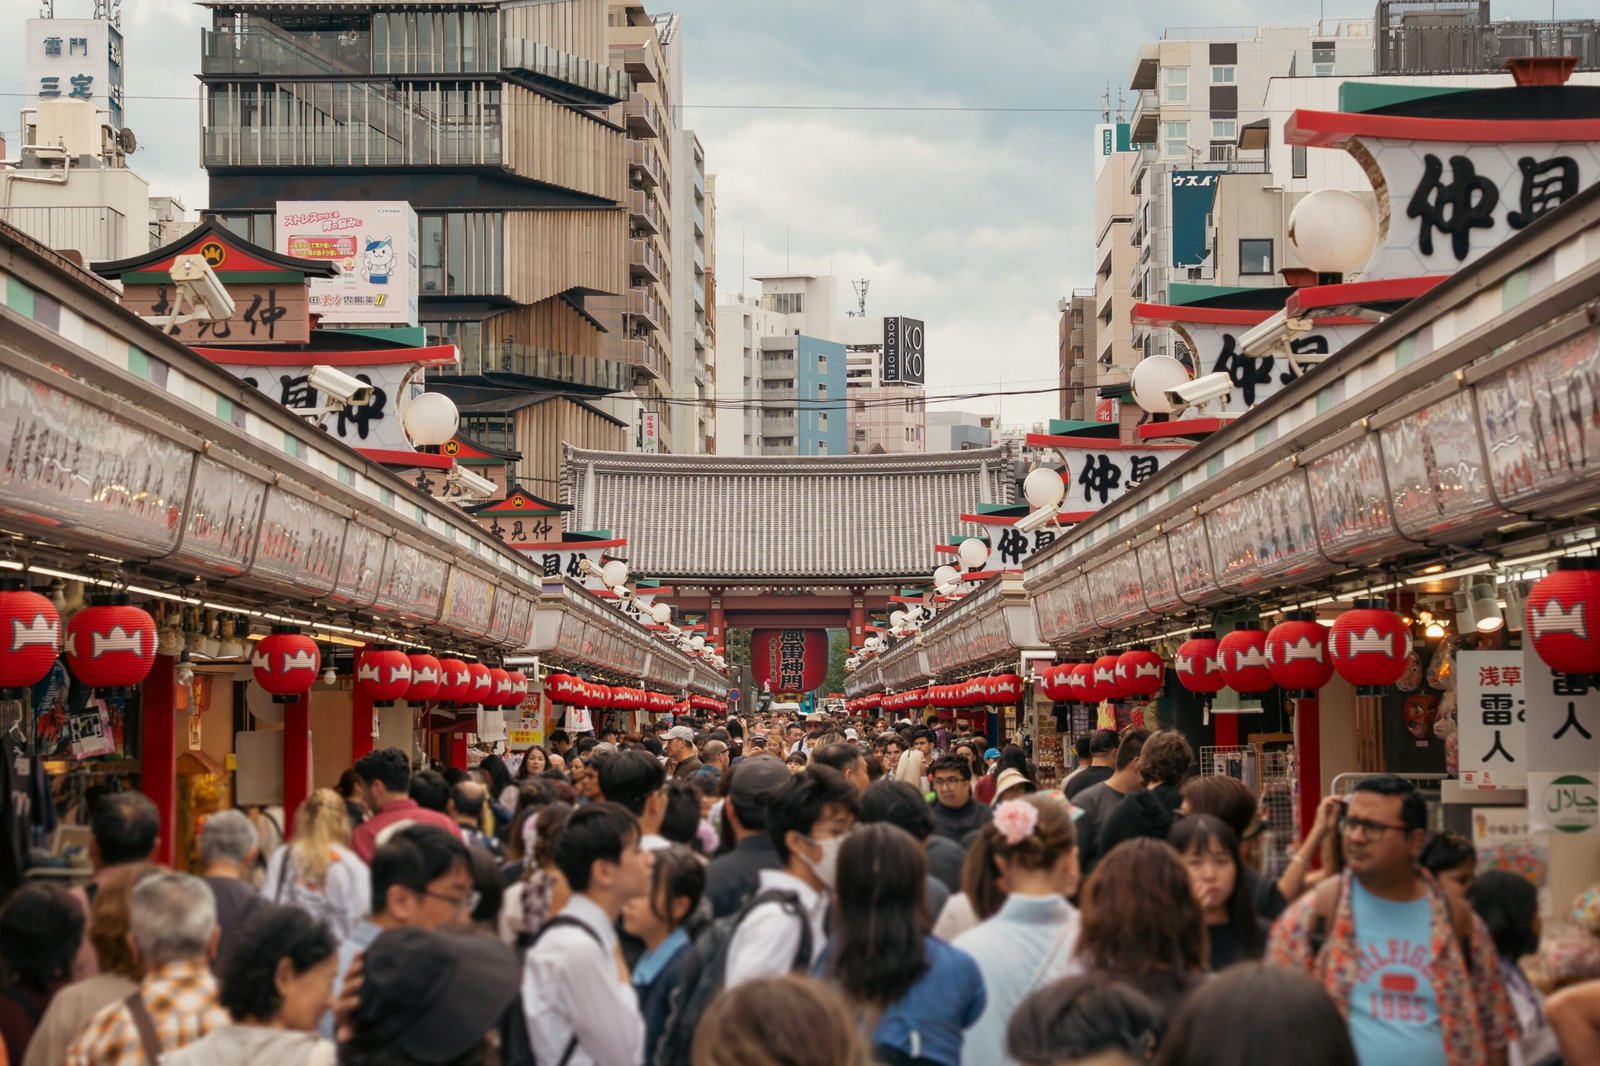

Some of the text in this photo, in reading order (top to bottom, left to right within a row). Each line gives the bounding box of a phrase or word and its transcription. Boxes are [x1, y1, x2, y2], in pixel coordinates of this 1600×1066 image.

[43, 36, 88, 57] 雷門
[39, 73, 94, 100] 三定
[284, 211, 340, 226] ストレスからくる
[887, 318, 896, 379] KOKO HOTEL
[905, 325, 922, 350] KO
[905, 352, 922, 377] KO
[1479, 666, 1522, 687] 浅草
[1552, 702, 1592, 740] 人
[1482, 730, 1515, 763] 人
[1547, 789, 1599, 813] حلال
